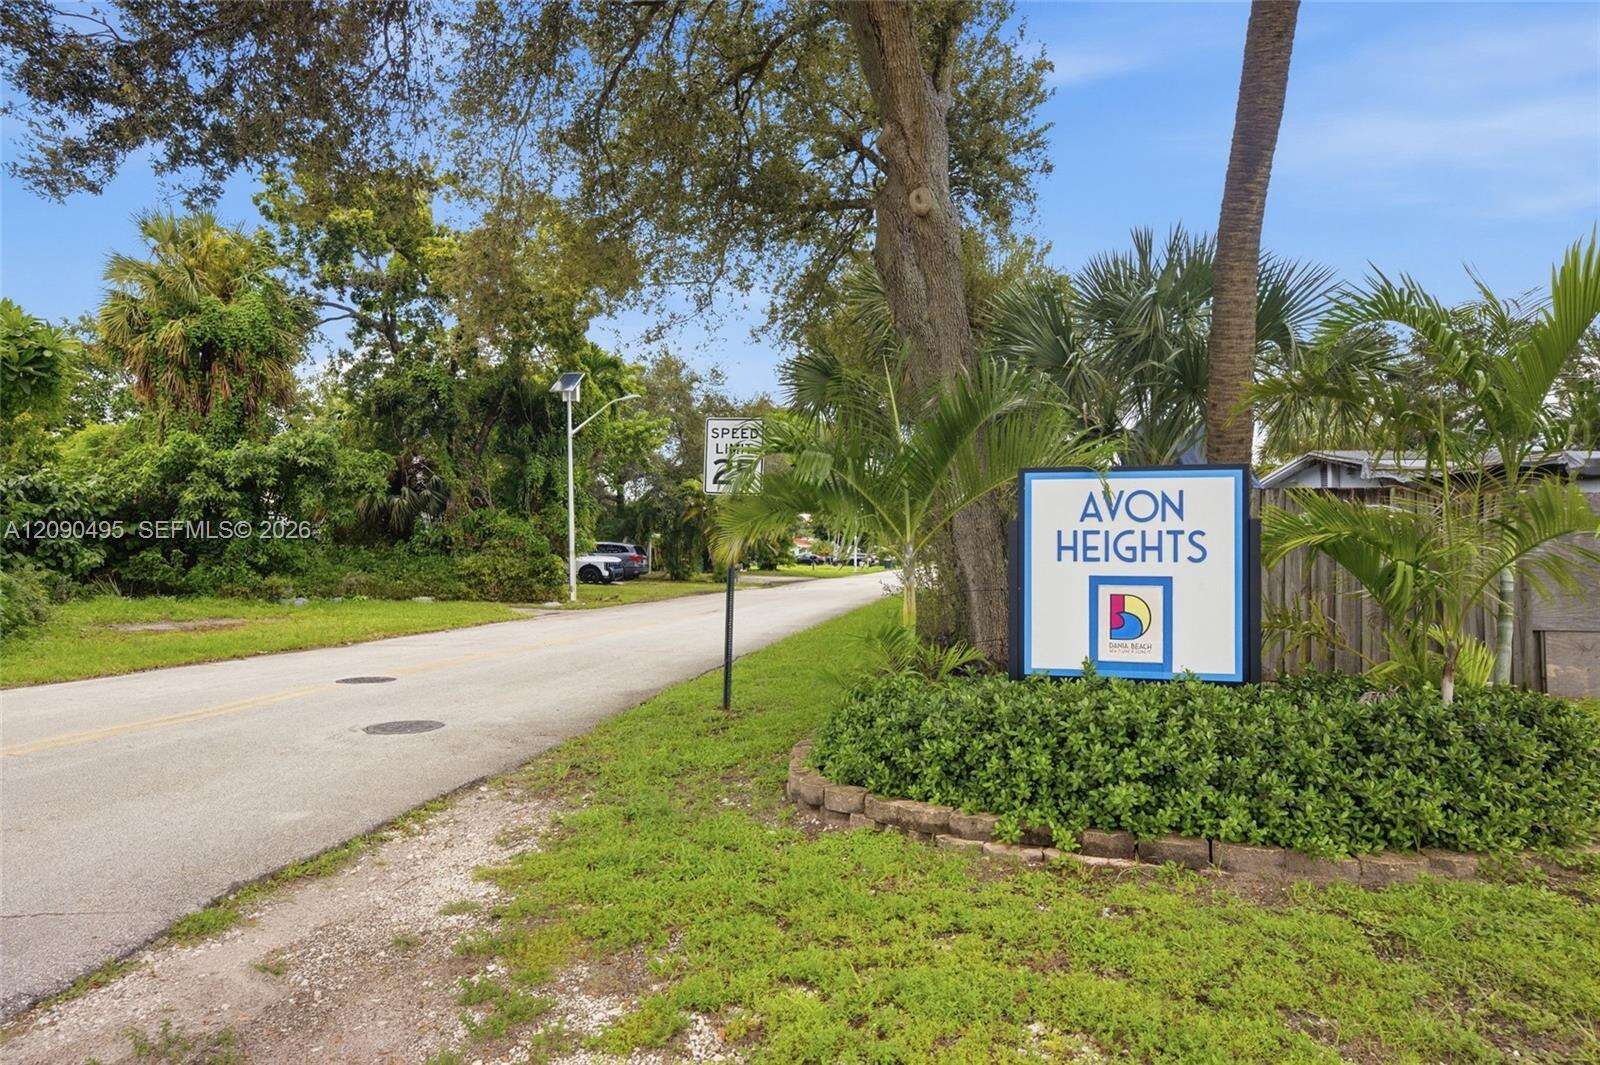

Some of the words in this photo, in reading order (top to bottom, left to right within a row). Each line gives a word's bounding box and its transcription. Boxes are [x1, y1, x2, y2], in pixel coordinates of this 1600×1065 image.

[711, 427, 759, 439] SPEED
[1079, 489, 1185, 523] AVON
[1056, 529, 1208, 564] HEIGHTS
[1130, 642, 1153, 650] BEACH
